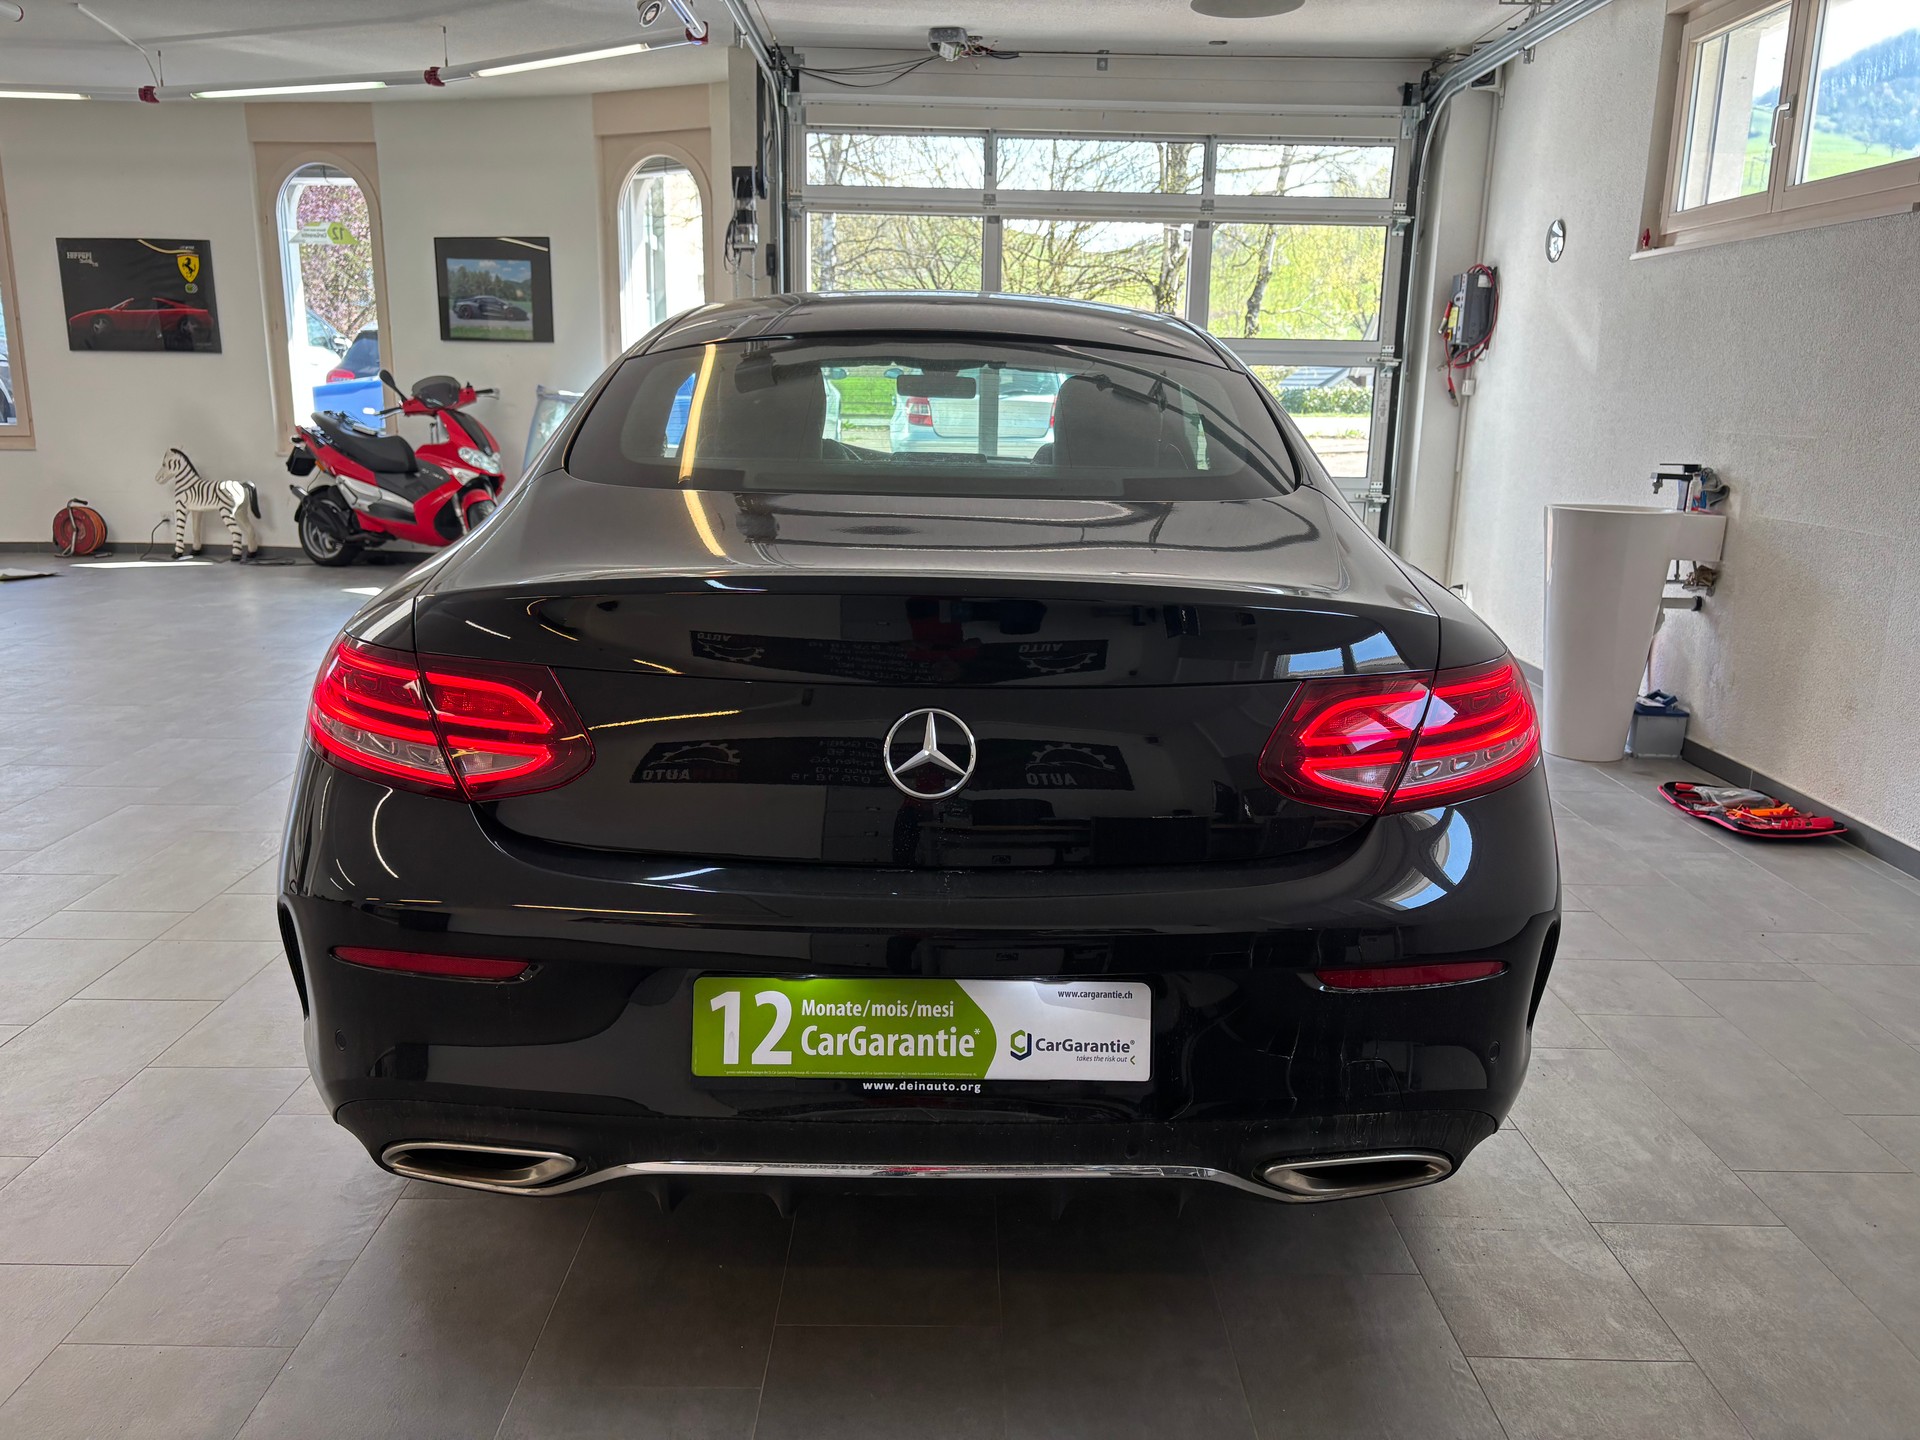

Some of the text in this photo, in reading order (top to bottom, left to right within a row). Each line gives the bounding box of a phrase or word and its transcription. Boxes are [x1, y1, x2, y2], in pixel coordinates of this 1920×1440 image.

[1057, 990, 1133, 1000] www.cargarantie.ch
[710, 990, 793, 1065] 12
[862, 1081, 981, 1093] www.deinauto.org
